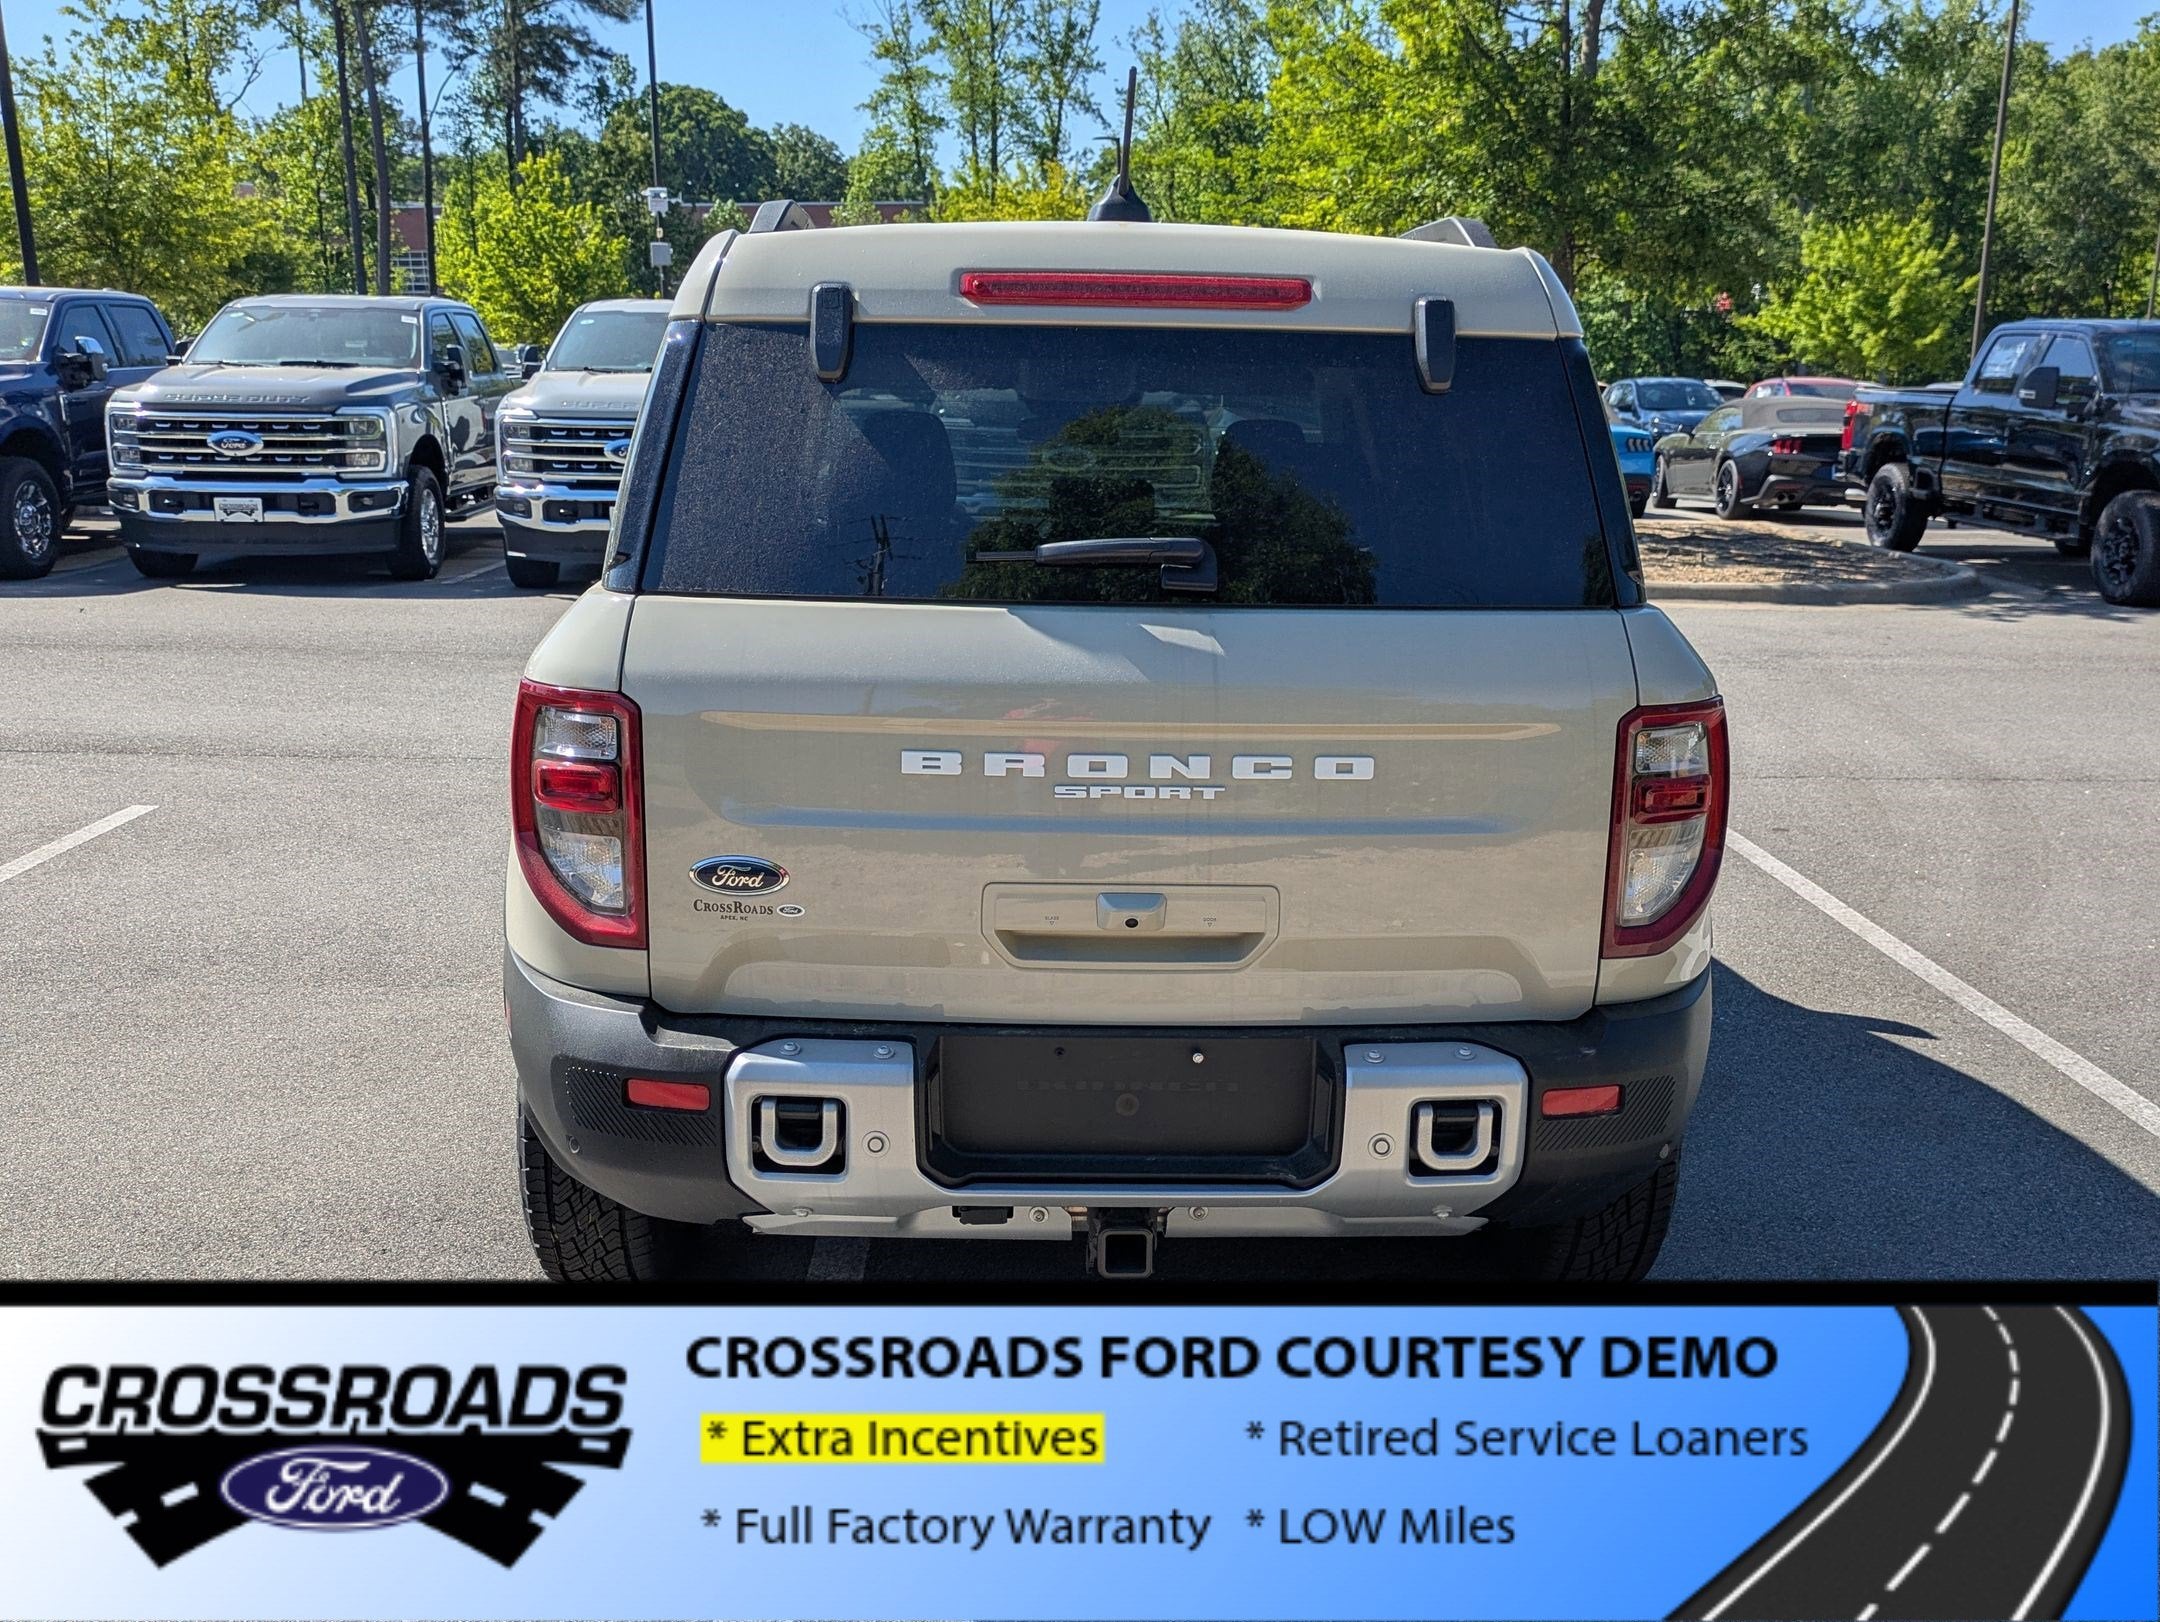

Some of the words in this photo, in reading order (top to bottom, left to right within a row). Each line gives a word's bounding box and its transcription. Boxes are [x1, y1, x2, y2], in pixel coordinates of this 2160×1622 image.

[901, 749, 1375, 781] BRONCO
[1054, 784, 1226, 800] SPORT
[711, 864, 766, 888] Ford
